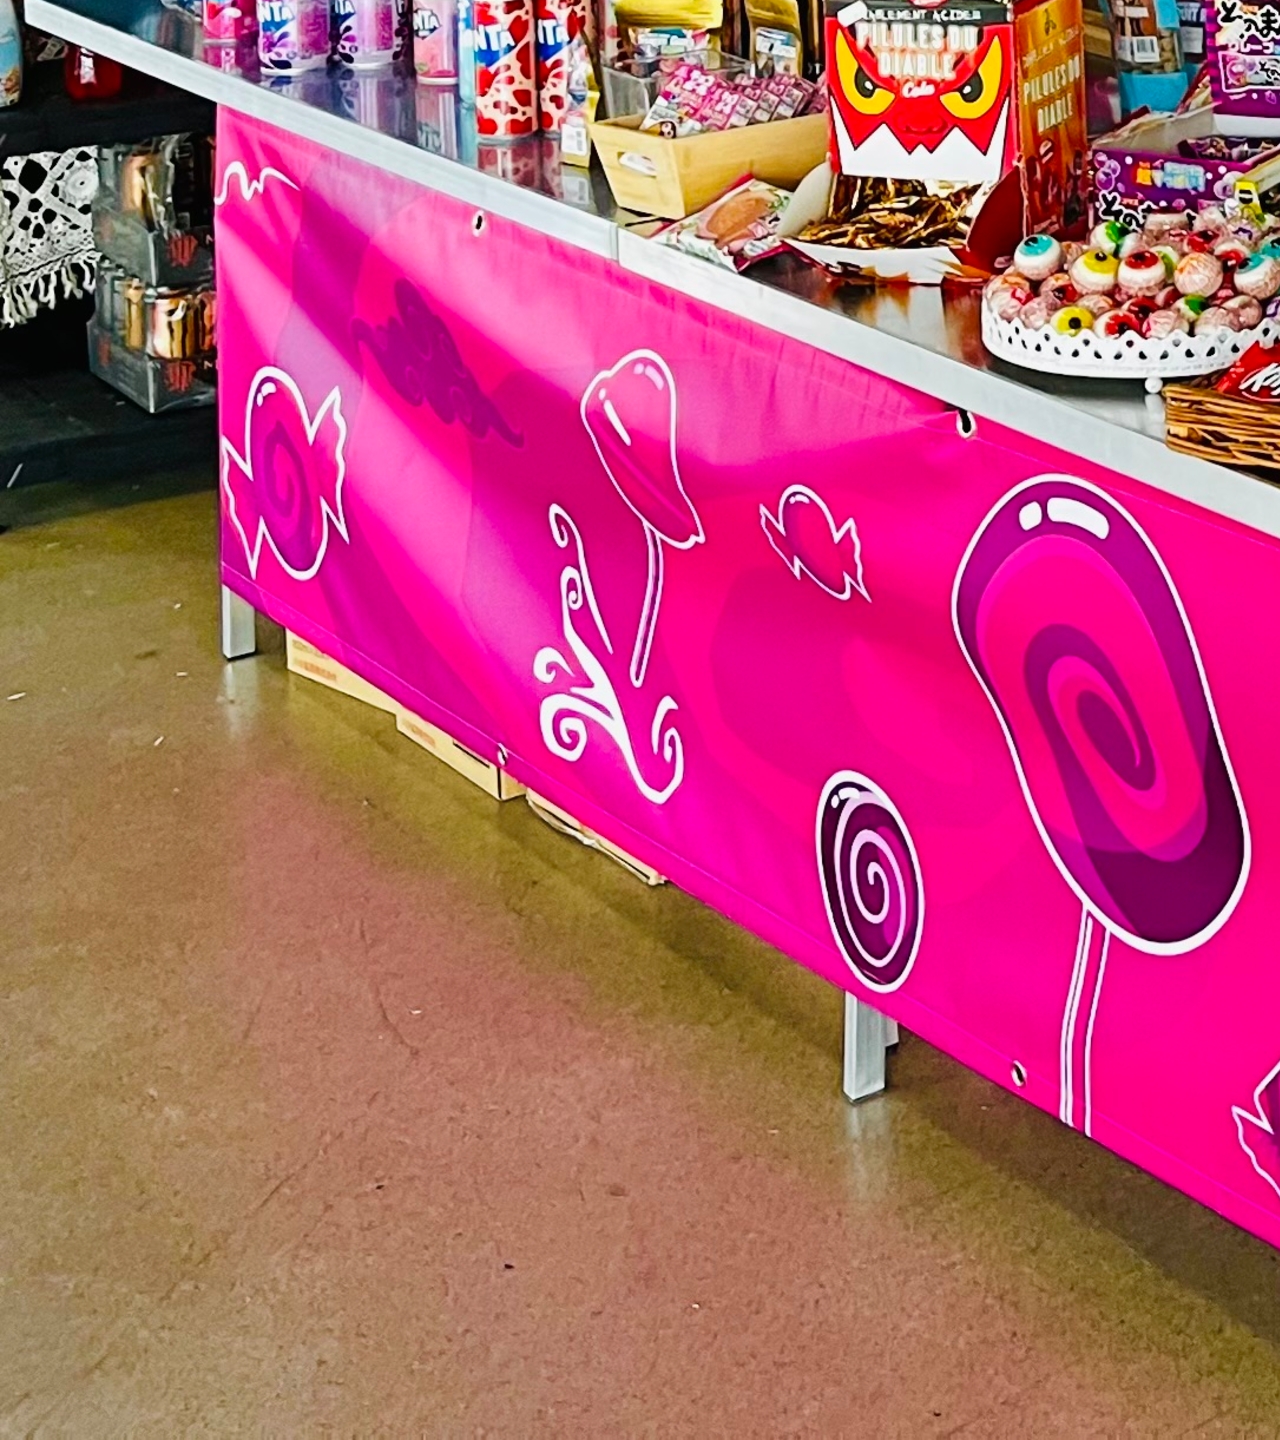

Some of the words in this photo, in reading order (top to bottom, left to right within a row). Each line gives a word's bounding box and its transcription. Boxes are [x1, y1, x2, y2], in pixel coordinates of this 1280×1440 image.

[856, 24, 945, 50] PILULES
[949, 26, 978, 51] DU
[879, 52, 954, 78] DIABLE
[1023, 63, 1067, 106] PILULES
[1038, 92, 1074, 133] DIABLE
